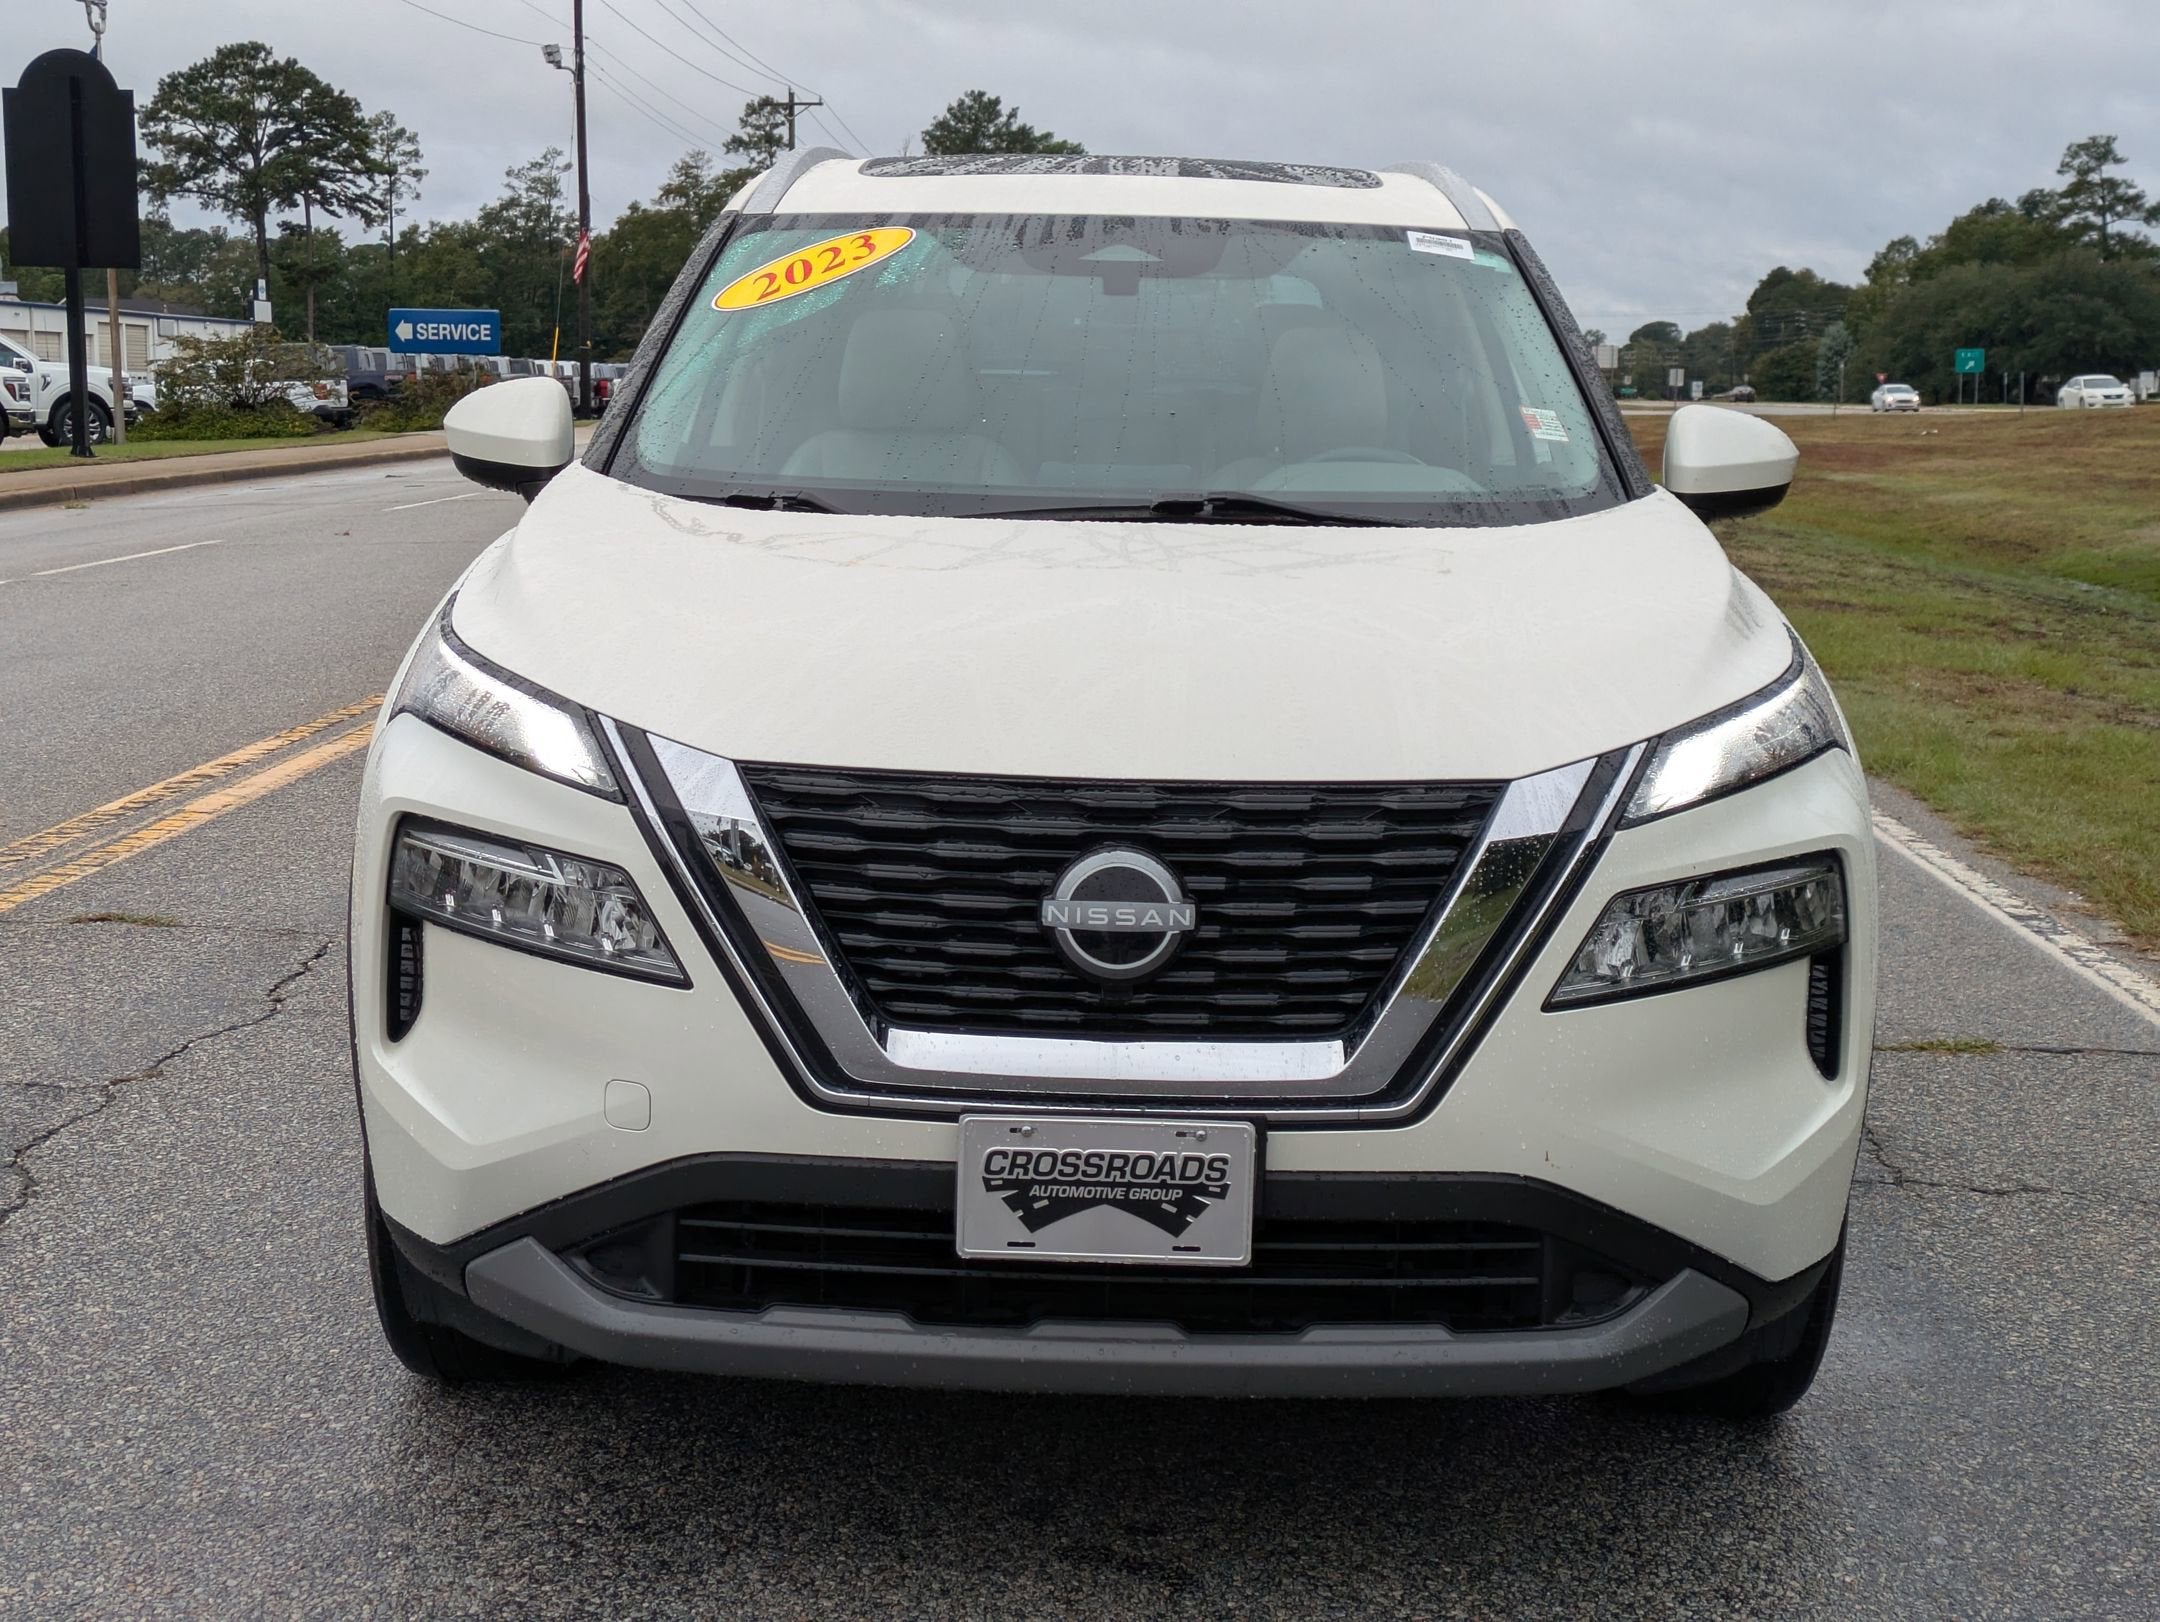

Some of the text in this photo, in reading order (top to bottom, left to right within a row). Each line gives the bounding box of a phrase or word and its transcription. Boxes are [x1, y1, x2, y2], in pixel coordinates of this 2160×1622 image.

[753, 234, 877, 302] 2023
[416, 323, 492, 341] SERVICE
[1047, 905, 1190, 926] NISSAN
[983, 1150, 1230, 1184] CROSSROADS
[1029, 1184, 1183, 1201] AUTOMOTIVE GROUP
